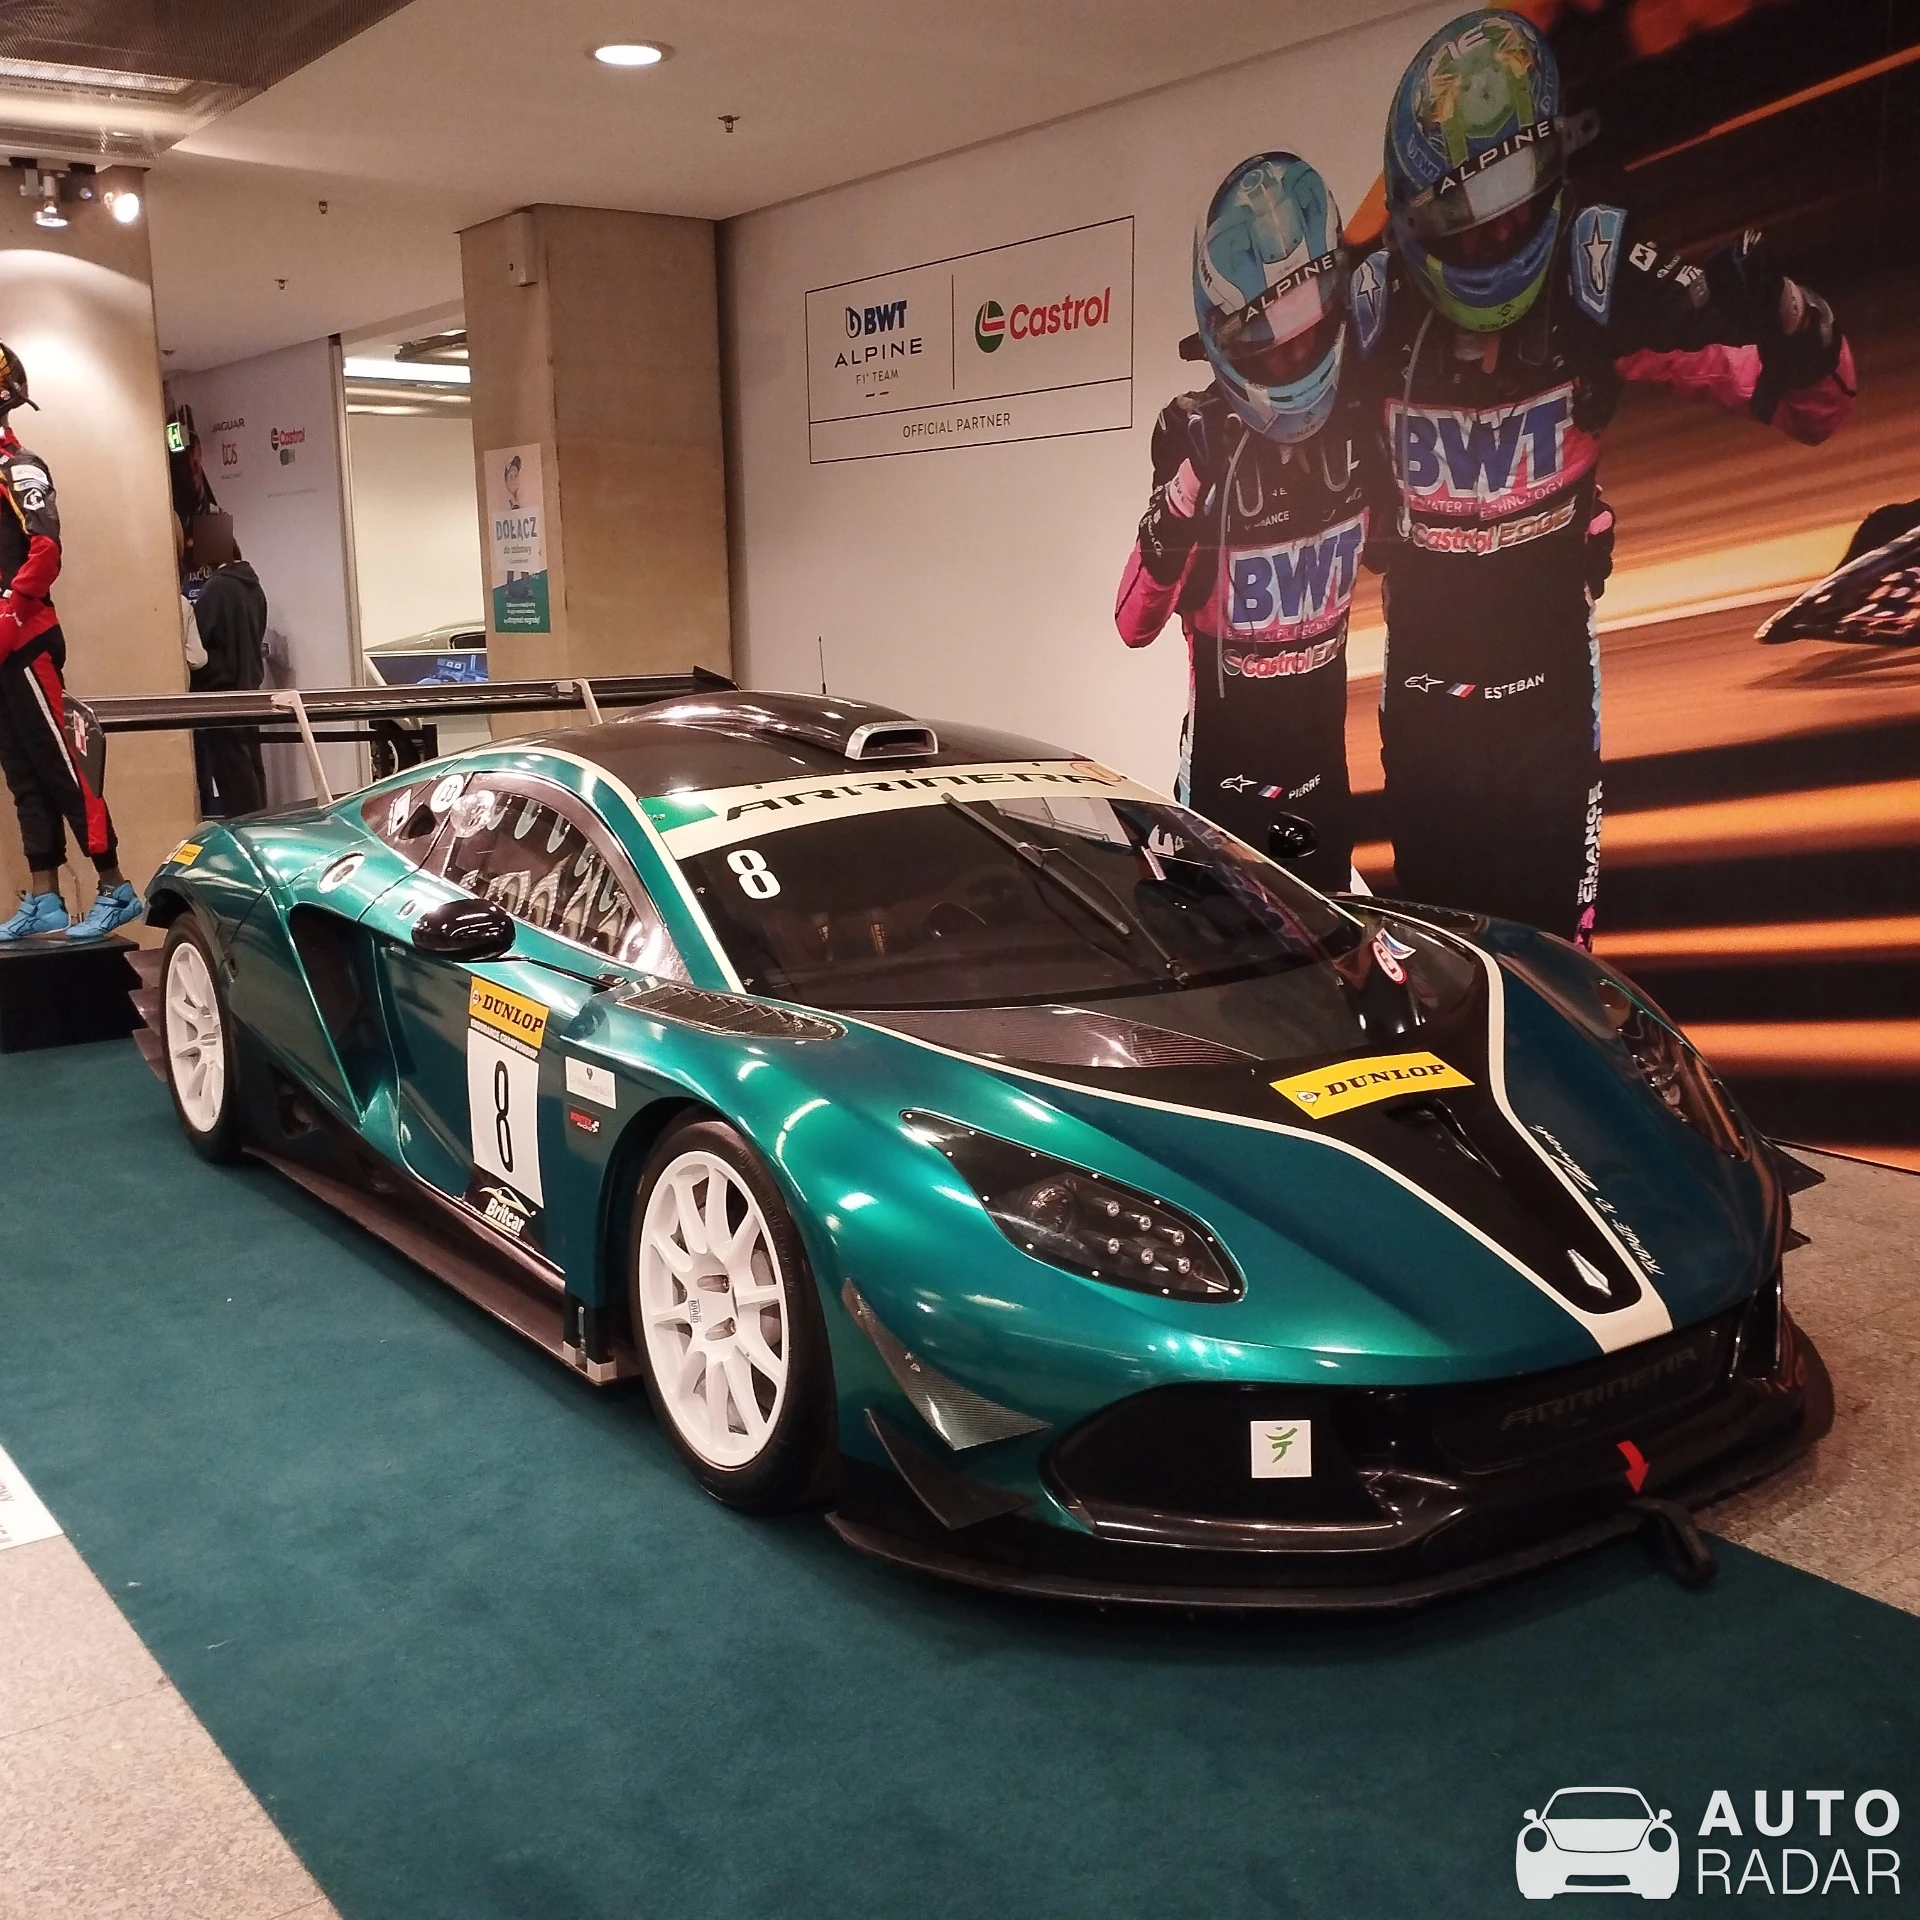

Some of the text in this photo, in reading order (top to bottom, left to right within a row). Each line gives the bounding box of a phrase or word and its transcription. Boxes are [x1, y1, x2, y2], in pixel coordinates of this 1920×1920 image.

[1440, 120, 1551, 194] ALPINE
[1245, 254, 1335, 322] ALPINE
[864, 301, 908, 336] BWT
[1010, 287, 1111, 340] Castrol
[834, 337, 923, 369] ALPINE
[872, 369, 900, 383] TEAM
[212, 418, 245, 433] JAGUAR
[279, 427, 306, 447] Castrol
[902, 412, 1011, 438] OFFICIAL PARTNER
[1394, 391, 1573, 497] BWT
[495, 516, 538, 541] DOŁĄCZ
[1412, 522, 1494, 556] Castrol
[1231, 521, 1364, 625] BWT
[1242, 647, 1309, 679] Castrol
[1484, 674, 1546, 699] ESTEBAN
[726, 772, 1117, 822] ARRINERA
[1288, 774, 1321, 800] PIERRE
[725, 849, 782, 900] 8
[482, 994, 544, 1033] DUNLOP
[1325, 1062, 1447, 1097] DUNLOP
[494, 1060, 514, 1173] 8
[485, 1199, 526, 1234] Britcar
